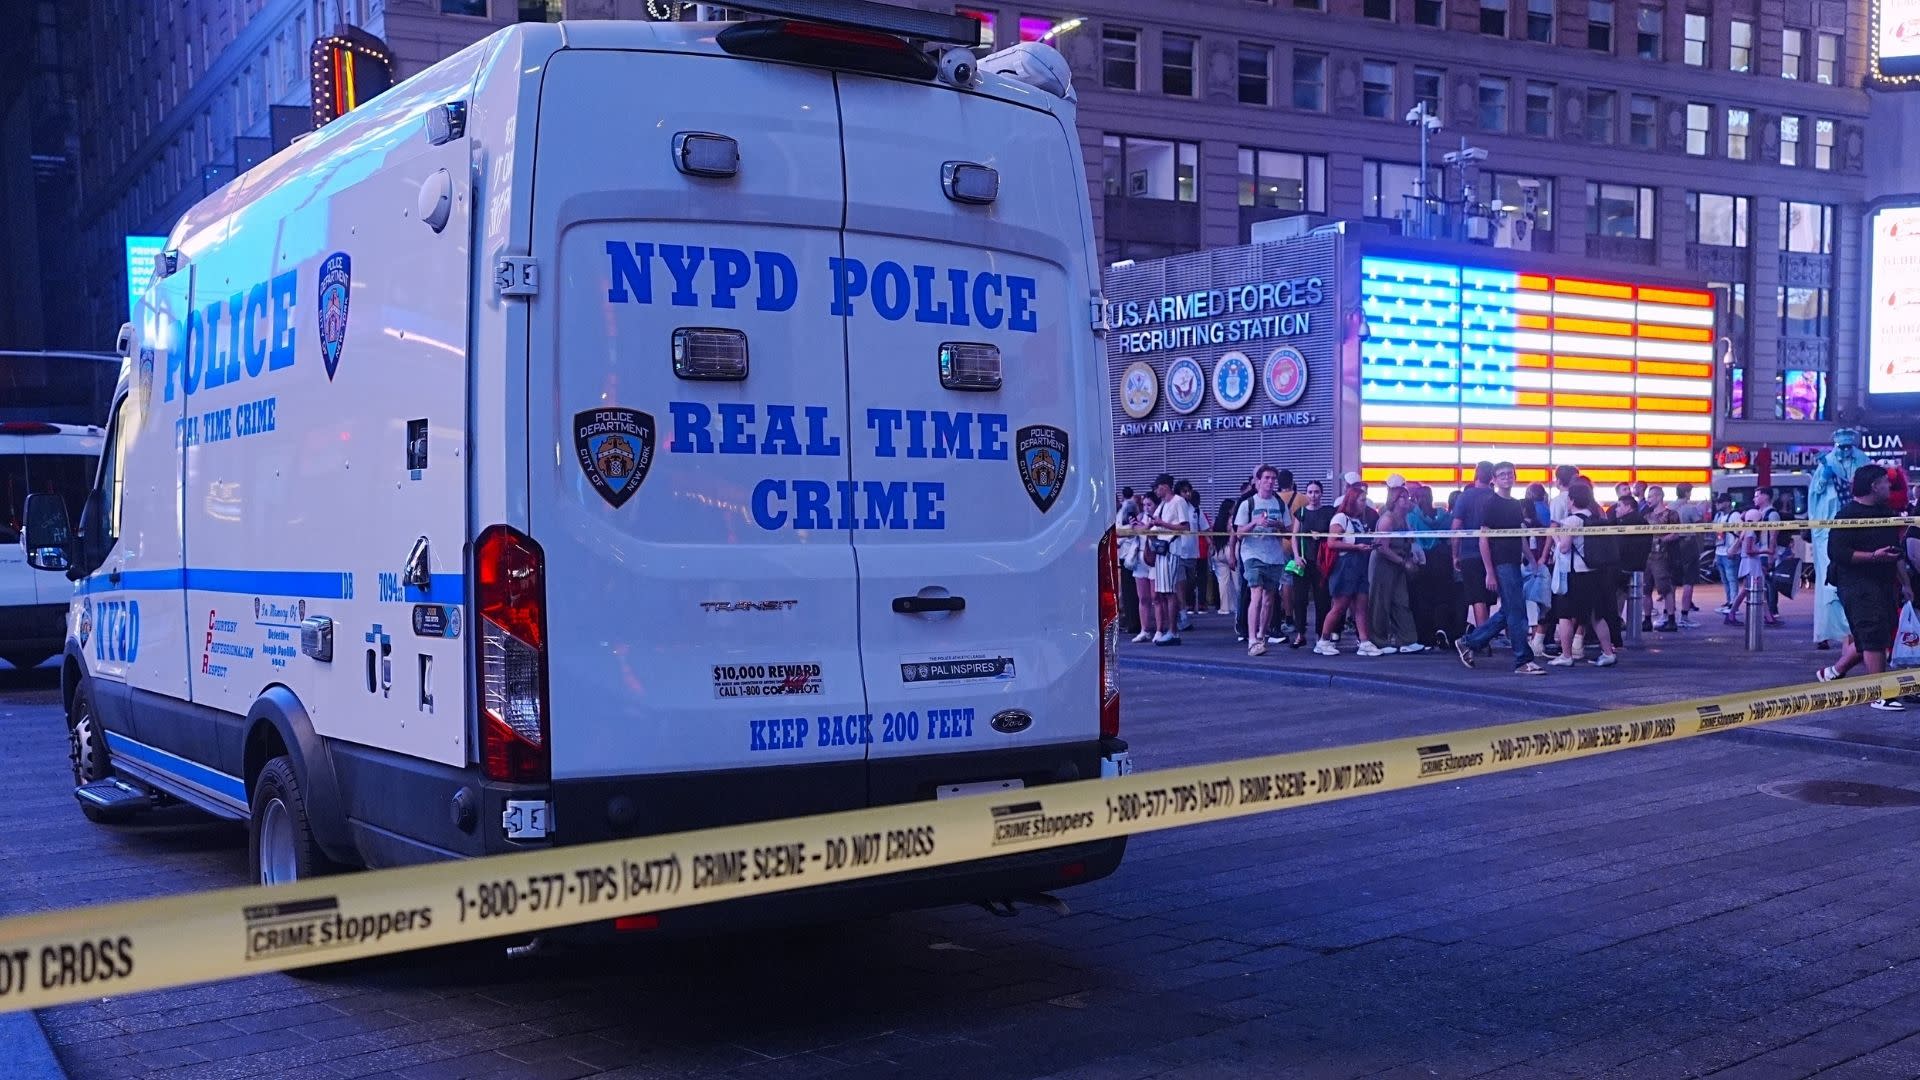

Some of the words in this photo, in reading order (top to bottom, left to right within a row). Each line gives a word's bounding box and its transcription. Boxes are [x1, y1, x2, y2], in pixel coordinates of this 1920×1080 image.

[327, 256, 343, 273] POLICE
[320, 269, 349, 296] DEPARTMENT
[606, 240, 798, 312] NYPD
[829, 256, 1037, 333] POLICE
[1108, 301, 1142, 329] U.S.
[1145, 289, 1225, 324] ARMED
[1228, 277, 1323, 313] FORCES
[164, 269, 297, 403] POLICE
[1119, 323, 1224, 353] RECRUITING
[1228, 312, 1310, 342] STATION
[204, 408, 232, 443] TIME
[236, 398, 276, 437] CRIME
[580, 421, 650, 438] DEPARTMENT
[596, 411, 634, 423] POLICE
[669, 401, 840, 457] REAL
[867, 408, 1008, 461] TIME
[1120, 423, 1147, 436] ARMY
[1154, 420, 1184, 433] NAVY
[1216, 416, 1252, 429] FORCE
[1263, 411, 1310, 427] MARINES
[1020, 437, 1065, 453] DEPARTMENT
[1031, 428, 1056, 439] POLICE
[580, 448, 595, 472] CITY
[591, 474, 605, 487] OF
[627, 470, 642, 491] NEW
[639, 446, 651, 469] YORK
[1020, 460, 1030, 480] CITY
[1027, 483, 1036, 494] OF
[1051, 481, 1061, 498] NEW
[1058, 459, 1066, 479] YORK
[751, 479, 945, 531] CRIME
[379, 572, 398, 601] 7094
[700, 600, 798, 612] TRANSIT
[209, 610, 238, 632] COURTESY
[205, 632, 254, 658] PROFESSIONALISM
[202, 654, 228, 677] RESPECT
[714, 665, 765, 681] $10,000
[768, 664, 820, 678] REWARD
[931, 666, 949, 675] PAL
[951, 663, 995, 674] INSPIRES
[719, 687, 738, 696] CALL
[739, 686, 760, 696] 1-800
[750, 718, 808, 751] KEEP
[817, 714, 873, 747] BACK
[882, 711, 919, 743] 200
[927, 708, 975, 740] FEET
[1002, 716, 1026, 728] Ford
[997, 822, 1030, 841] CRIME
[1106, 785, 1199, 824] 1-800-577-TIPS
[1199, 776, 1235, 812] (8477)
[1239, 776, 1272, 804] CRIME
[1274, 771, 1307, 800] SCENE
[1317, 768, 1332, 794] DO
[1333, 765, 1352, 791] NOT
[1353, 761, 1385, 788] CROSS
[253, 924, 314, 953] CRIME
[455, 867, 618, 923] 1-800-577-TIPS
[622, 852, 683, 901] (8477)
[692, 849, 745, 890] CRIME
[752, 842, 805, 881] SCENE
[825, 838, 847, 869] DO
[849, 832, 881, 866] NOT
[885, 825, 935, 861] CROSS
[0, 947, 29, 995] OT
[41, 935, 134, 989] CROSS
